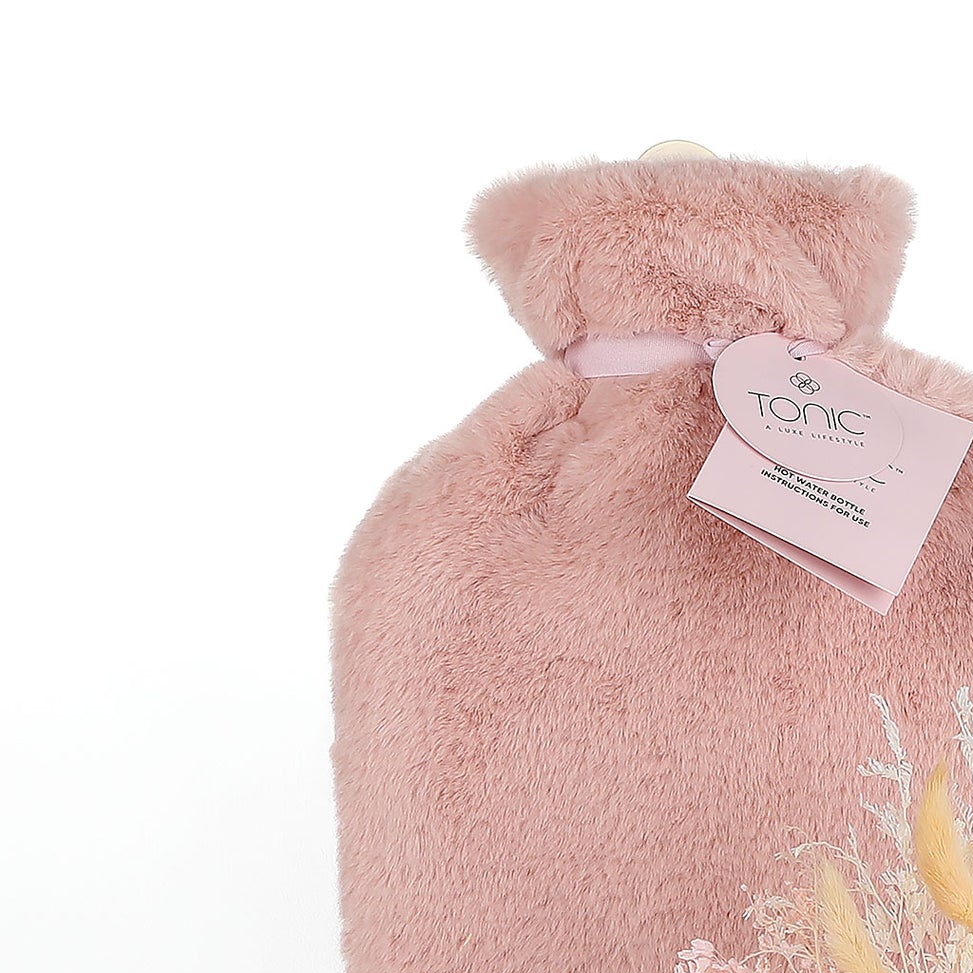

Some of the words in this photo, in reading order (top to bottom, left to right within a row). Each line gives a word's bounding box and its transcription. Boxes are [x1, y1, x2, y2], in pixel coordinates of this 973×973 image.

[778, 427, 803, 436] LUXE
[811, 433, 865, 447] LIFESTYLE
[761, 469, 828, 507] INSTRUCTIONS
[830, 504, 850, 518] FOR
[851, 514, 870, 528] USE
[774, 465, 795, 479] HOT
[796, 476, 829, 497] WATER
[830, 494, 866, 515] BOTTLE
